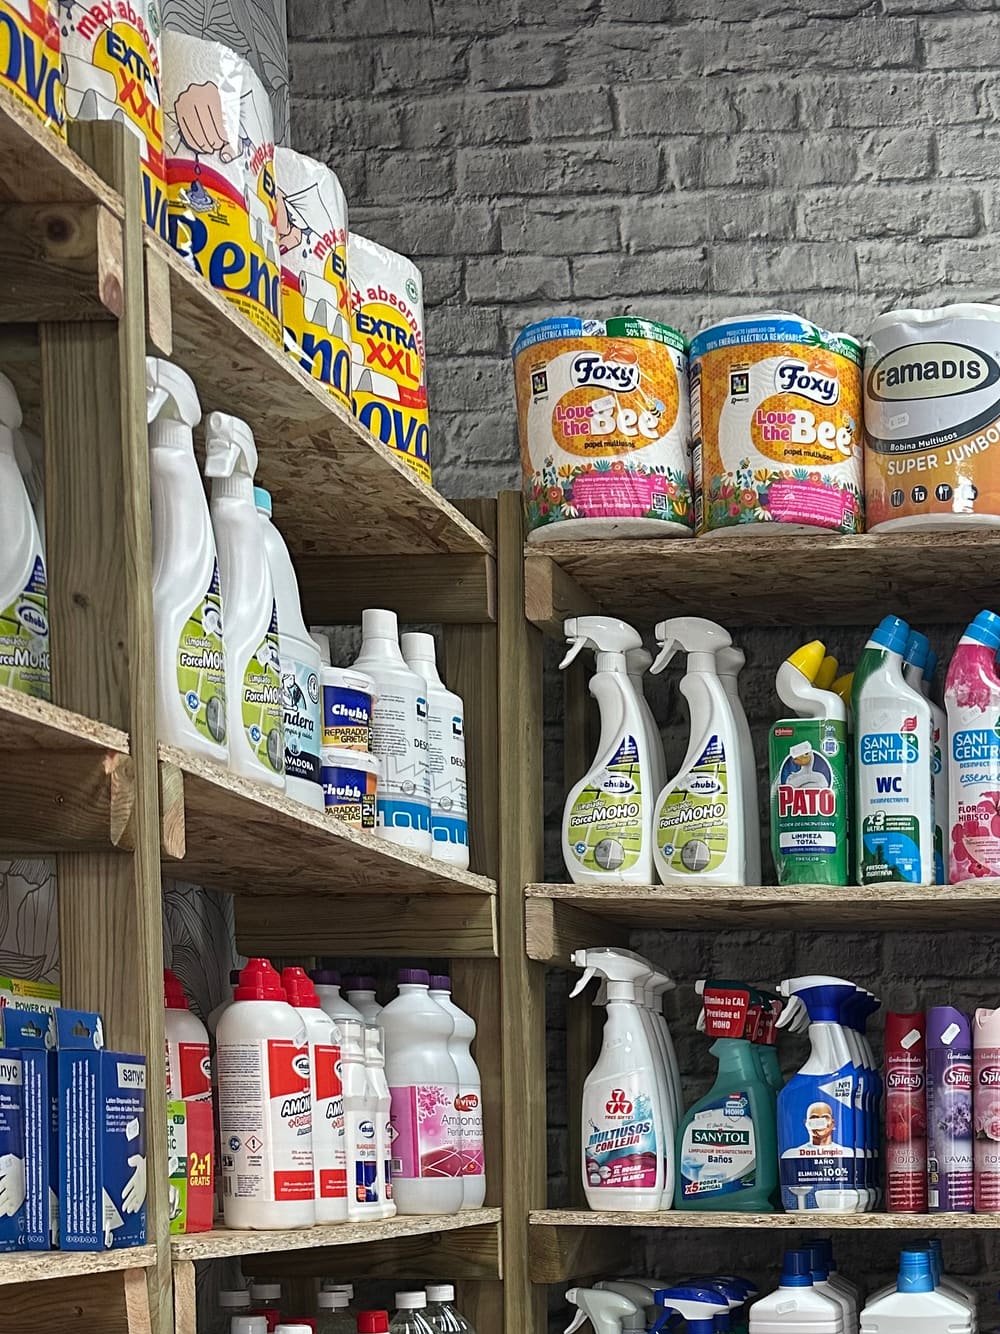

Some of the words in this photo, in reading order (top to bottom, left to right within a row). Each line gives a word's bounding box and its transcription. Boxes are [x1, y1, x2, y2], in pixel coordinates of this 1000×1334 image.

[356, 313, 418, 351] EXTRA
[366, 338, 420, 383] XXL
[574, 358, 635, 387] Foxy
[779, 365, 836, 399] Foxy
[563, 420, 590, 437] the
[590, 403, 660, 440] Bee
[763, 425, 789, 443] the
[791, 410, 851, 455] Bee
[888, 454, 938, 476] SUPER
[944, 431, 999, 465] JUMBO
[332, 704, 368, 722] Chubb
[324, 728, 367, 738] REPARADOR
[341, 735, 368, 744] GRIETAS
[956, 731, 988, 747] SANI
[864, 738, 894, 751] SANI
[863, 748, 917, 763] CENTRO
[876, 777, 902, 793] WC
[779, 787, 835, 817] PATO
[958, 805, 978, 814] FLOR
[570, 803, 640, 826] ForceMOHO
[659, 803, 725, 828] ForceMOHO
[958, 813, 990, 822] HIBISCO
[712, 1020, 730, 1029] MOHO
[888, 1072, 921, 1086] Splash
[589, 1122, 651, 1145] MULTIUSOS
[695, 1132, 747, 1143] SANYTOL
[190, 1152, 211, 1177] 2+1
[708, 1155, 733, 1164] Baños
[190, 1176, 211, 1187] GRATIS
